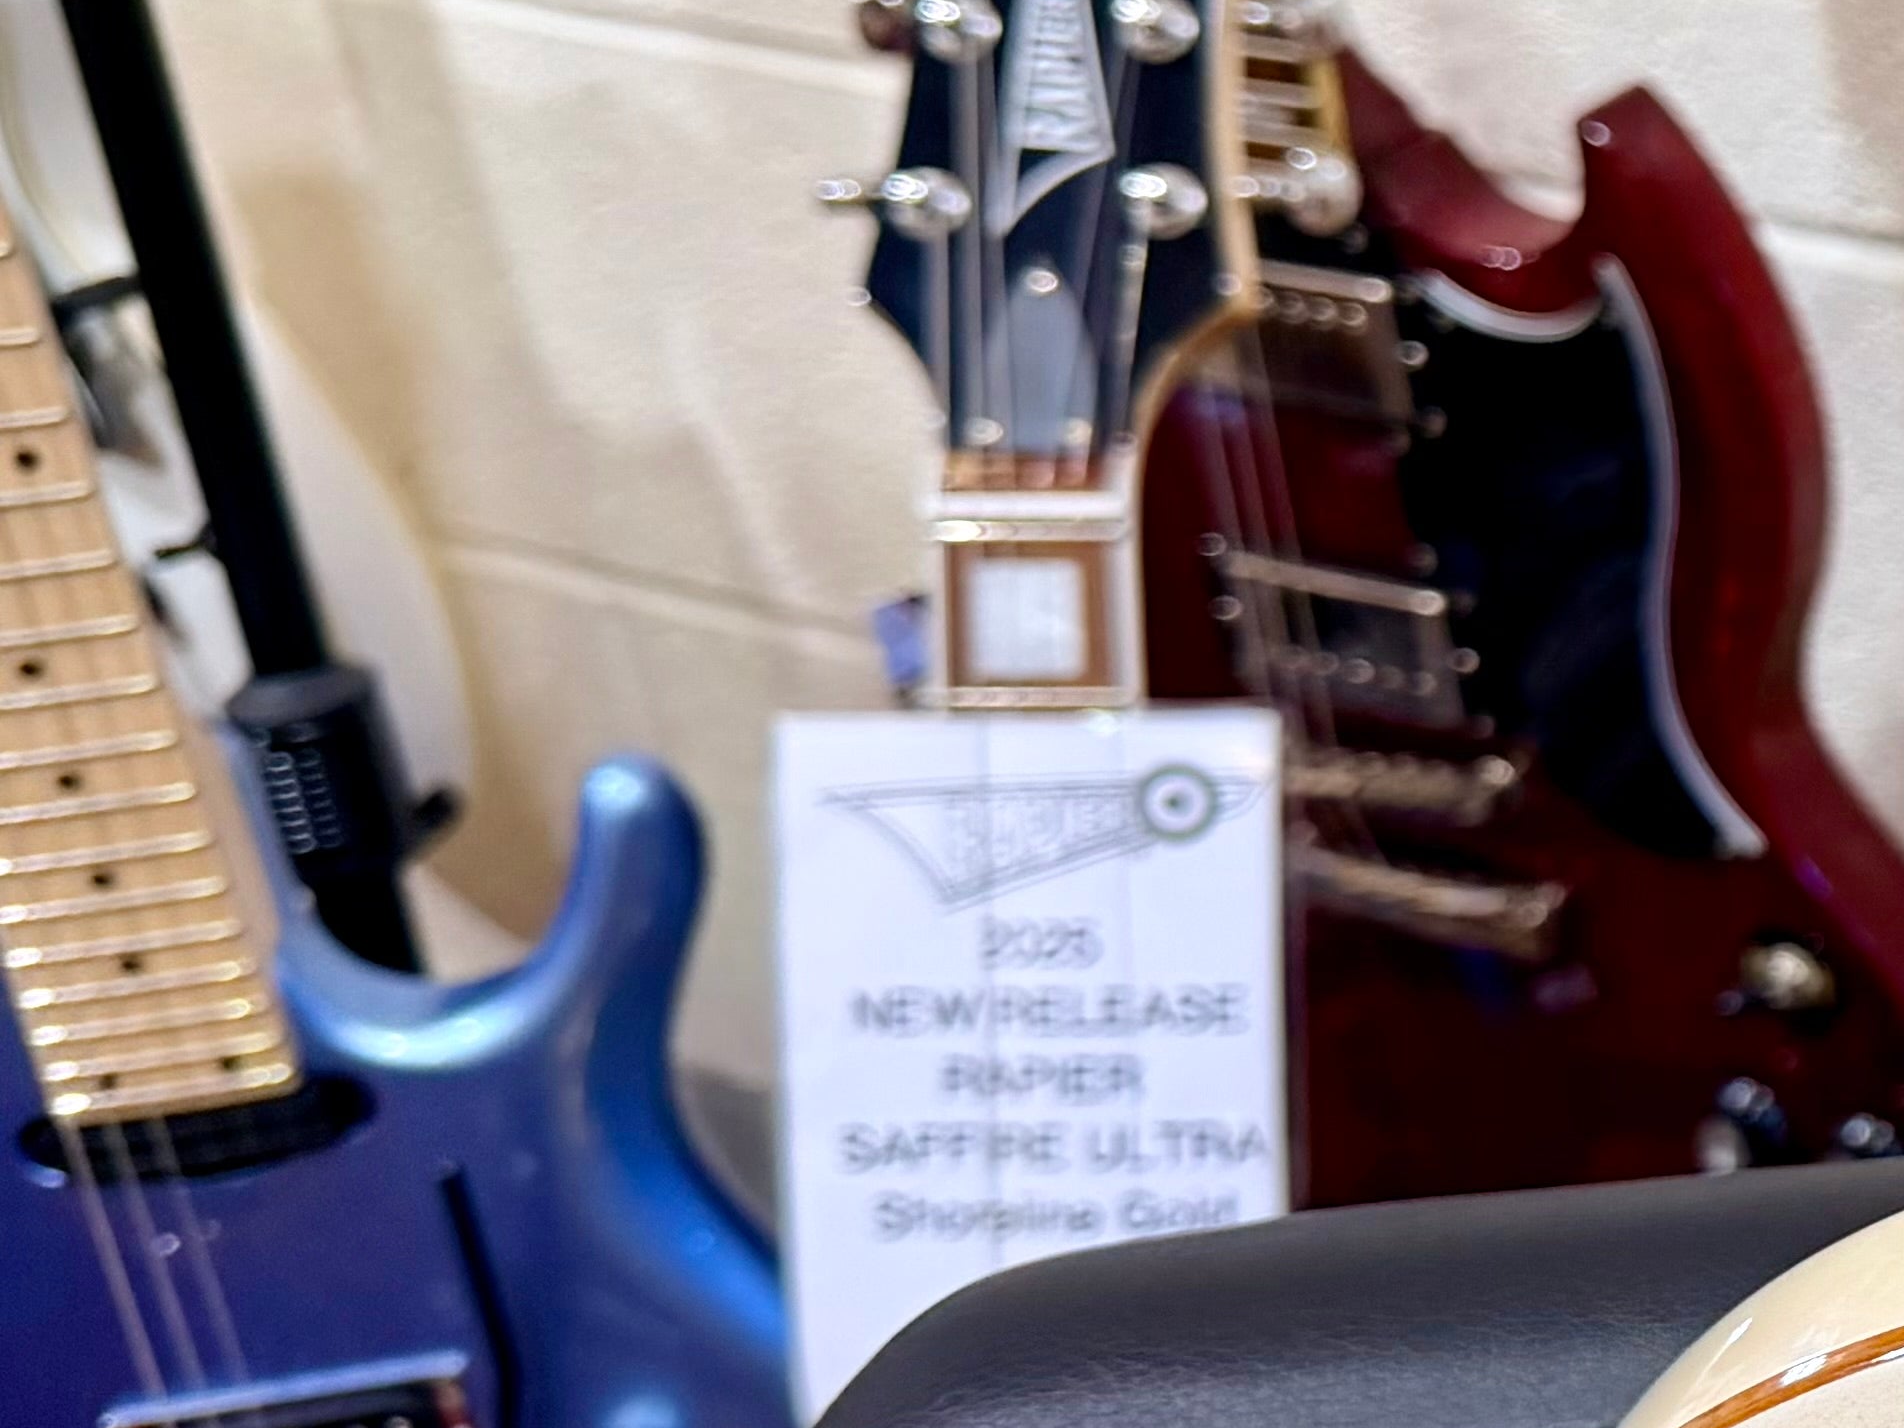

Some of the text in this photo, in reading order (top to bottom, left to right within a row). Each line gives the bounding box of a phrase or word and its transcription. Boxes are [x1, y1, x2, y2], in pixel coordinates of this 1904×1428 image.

[853, 984, 1250, 1036] NEW RELEASE
[1092, 1119, 1266, 1174] ULTRA
